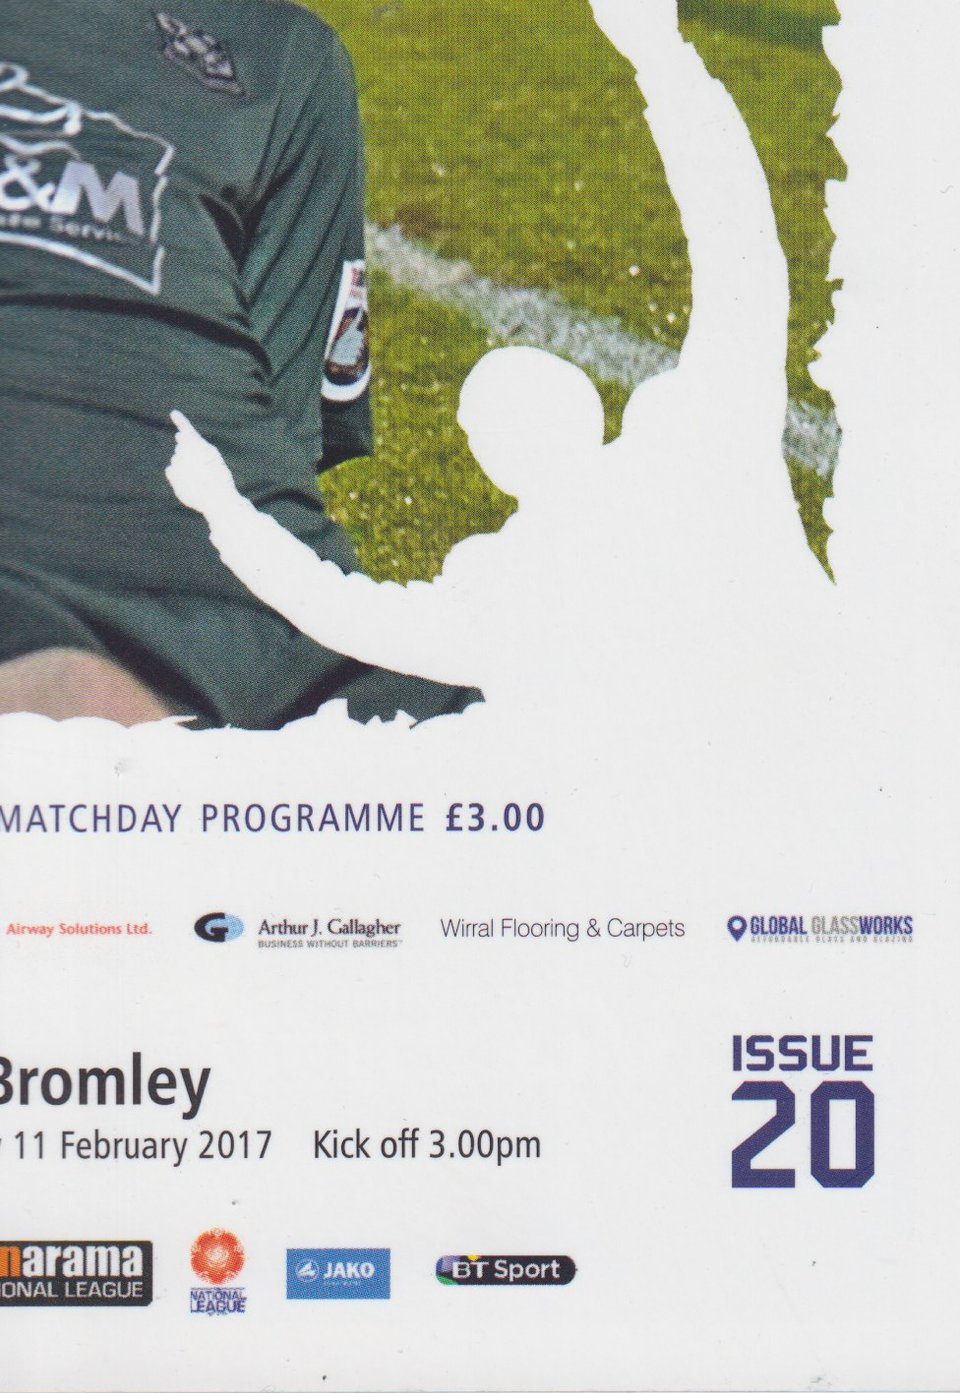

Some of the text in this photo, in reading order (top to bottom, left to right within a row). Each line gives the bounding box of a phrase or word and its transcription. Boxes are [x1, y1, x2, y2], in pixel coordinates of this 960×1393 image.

[203, 803, 424, 832] PROGRAMME
[446, 803, 544, 831] £3.00
[7, 923, 152, 938] Airway Solutions Ltd.
[259, 919, 401, 938] Arthur J. Gallagher
[441, 918, 685, 942] Wirral Flooring & Carpets
[750, 915, 913, 936] GLOBAL GLASSWORKS
[258, 940, 303, 948] BUSINESS
[306, 940, 348, 948] WITHOUT
[733, 1035, 873, 1071] ISSUE
[732, 1081, 875, 1188] 20
[15, 1131, 43, 1159] 11
[62, 1129, 187, 1167] February
[199, 1130, 271, 1158] 2017
[315, 1128, 370, 1158] Kick
[381, 1128, 419, 1158] off
[430, 1129, 540, 1166] 3.00pm
[324, 1262, 375, 1279] JAKO
[452, 1260, 561, 1281] BT Sport
[65, 1281, 144, 1299] LEAGUE
[190, 1290, 245, 1300] NATIONAL
[190, 1298, 245, 1313] LEAGUE
